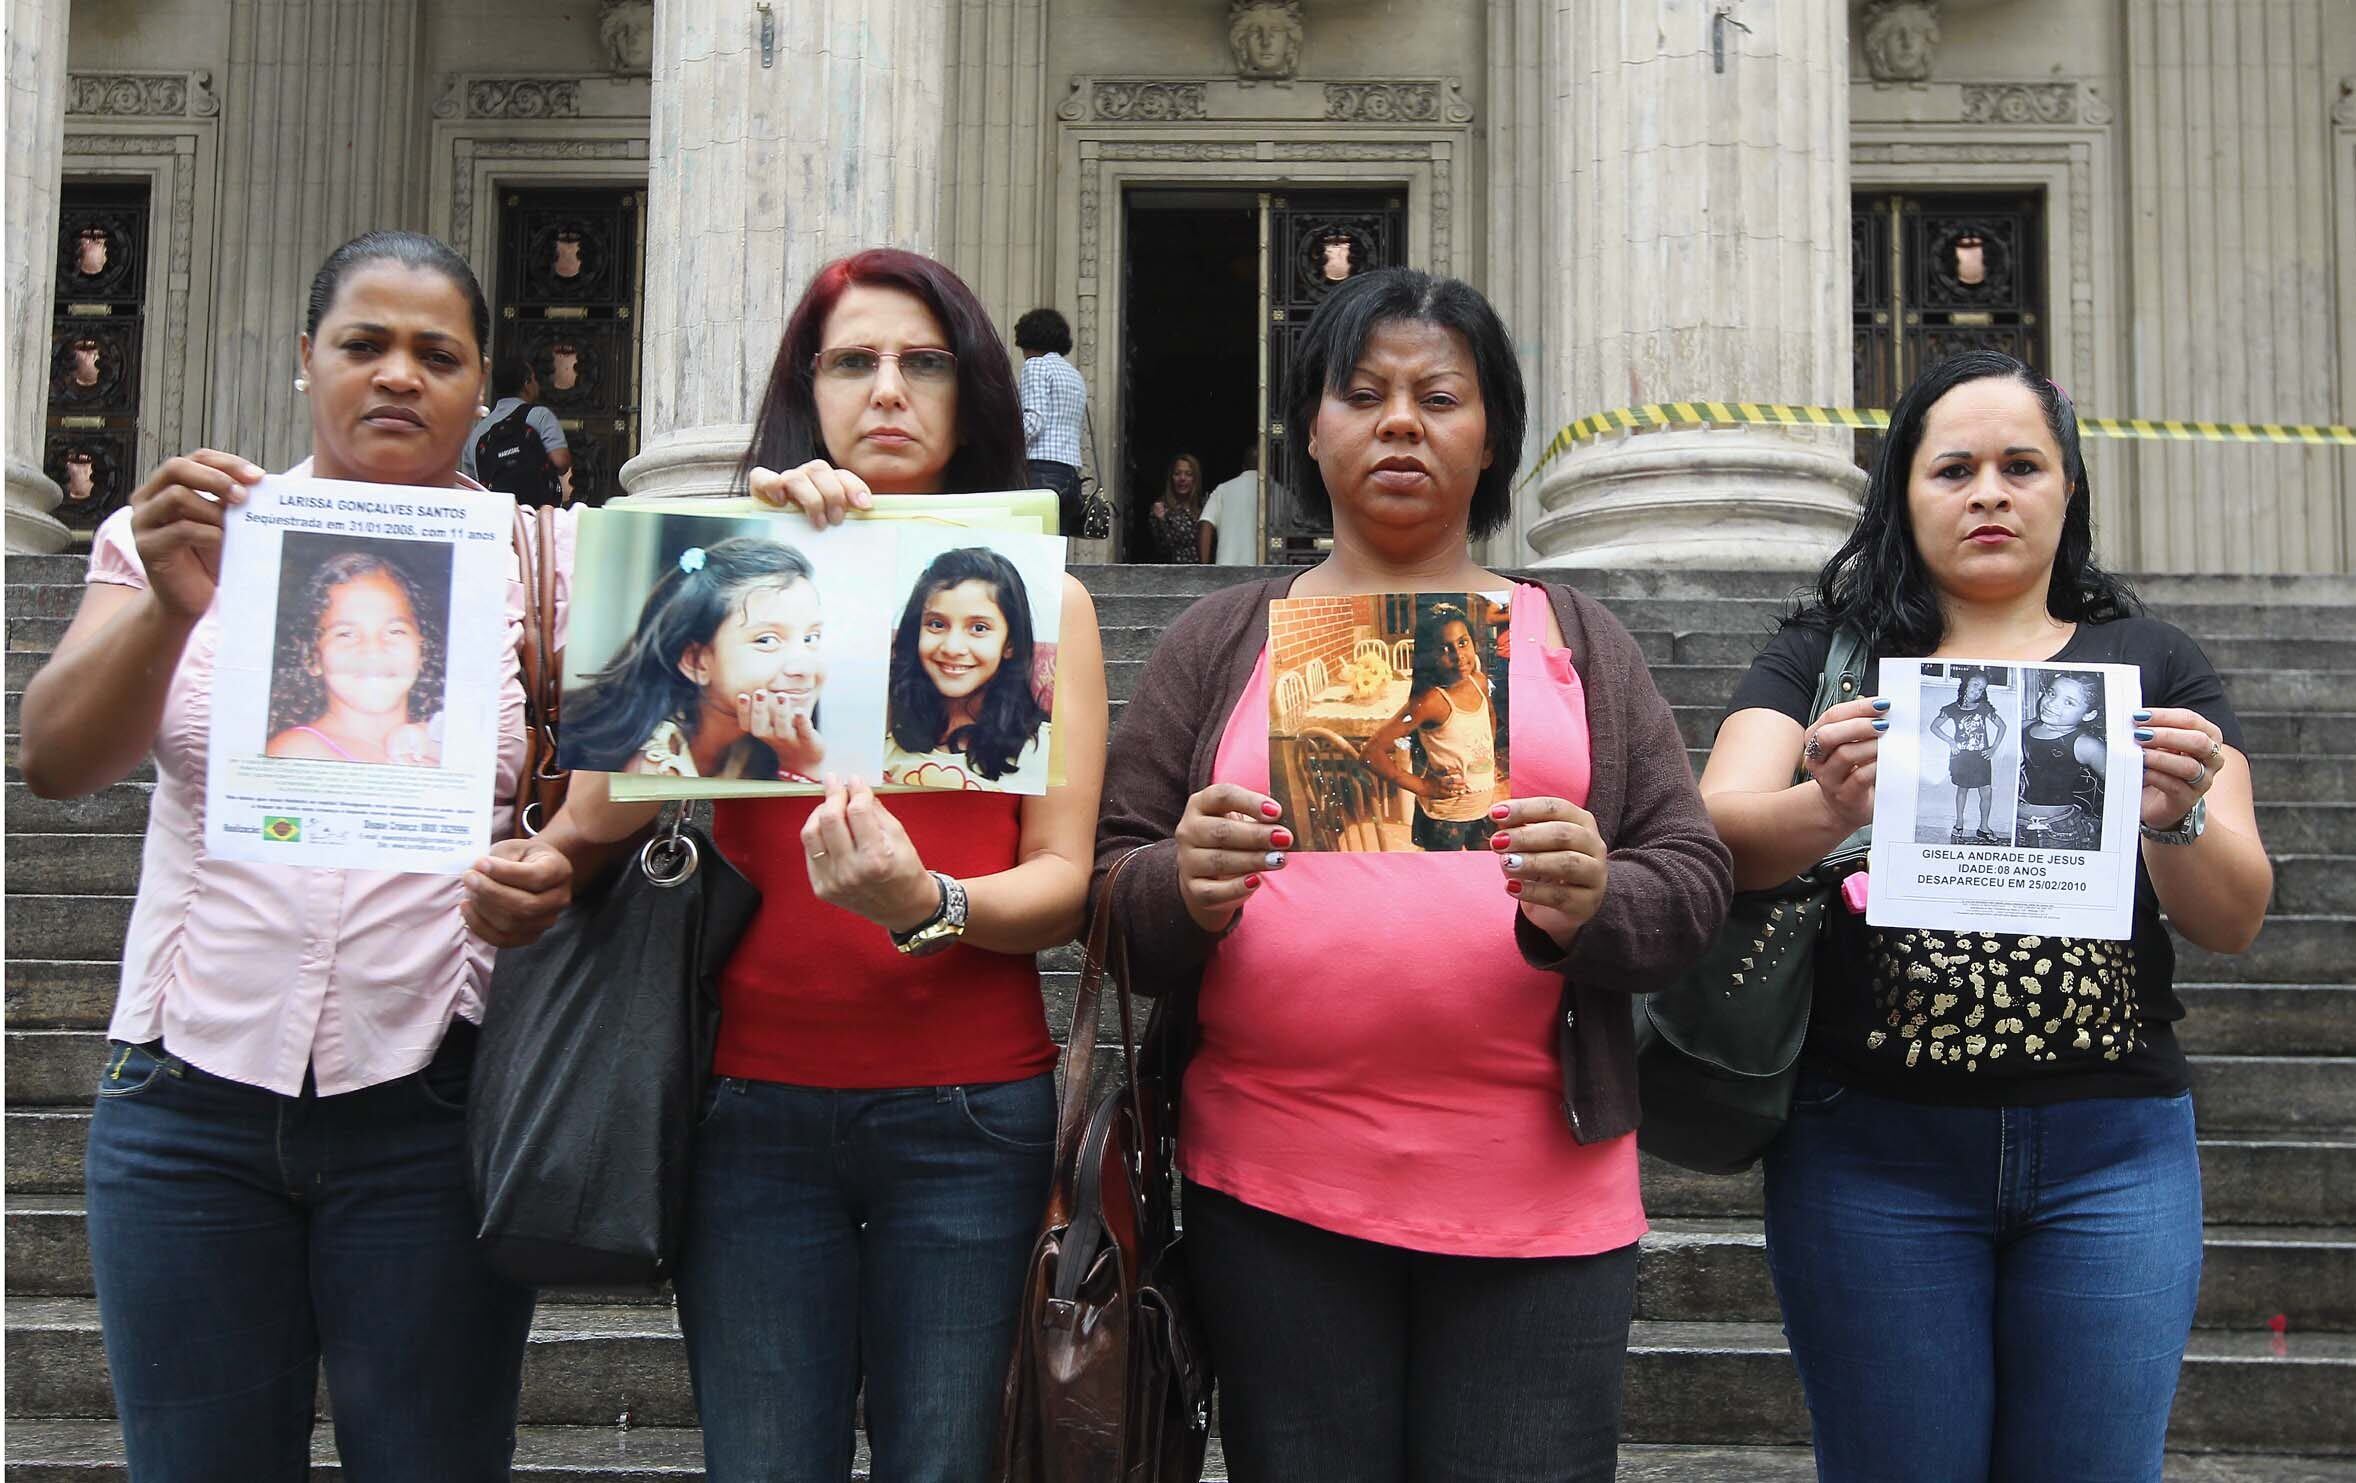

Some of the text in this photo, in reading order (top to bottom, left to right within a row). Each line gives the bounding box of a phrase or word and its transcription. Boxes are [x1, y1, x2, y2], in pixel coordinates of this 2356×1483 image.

[279, 494, 333, 510] LARISSA
[417, 506, 468, 520] SANTOS
[326, 521, 345, 530] em
[421, 528, 447, 538] com
[467, 531, 496, 541] anos
[1922, 849, 2086, 866] GISELA ANDRADE DE JESUS
[1958, 863, 2047, 877] IDADE:08 ANOS
[1917, 874, 2087, 892] DESAPARECEU EM 25/02/2010
